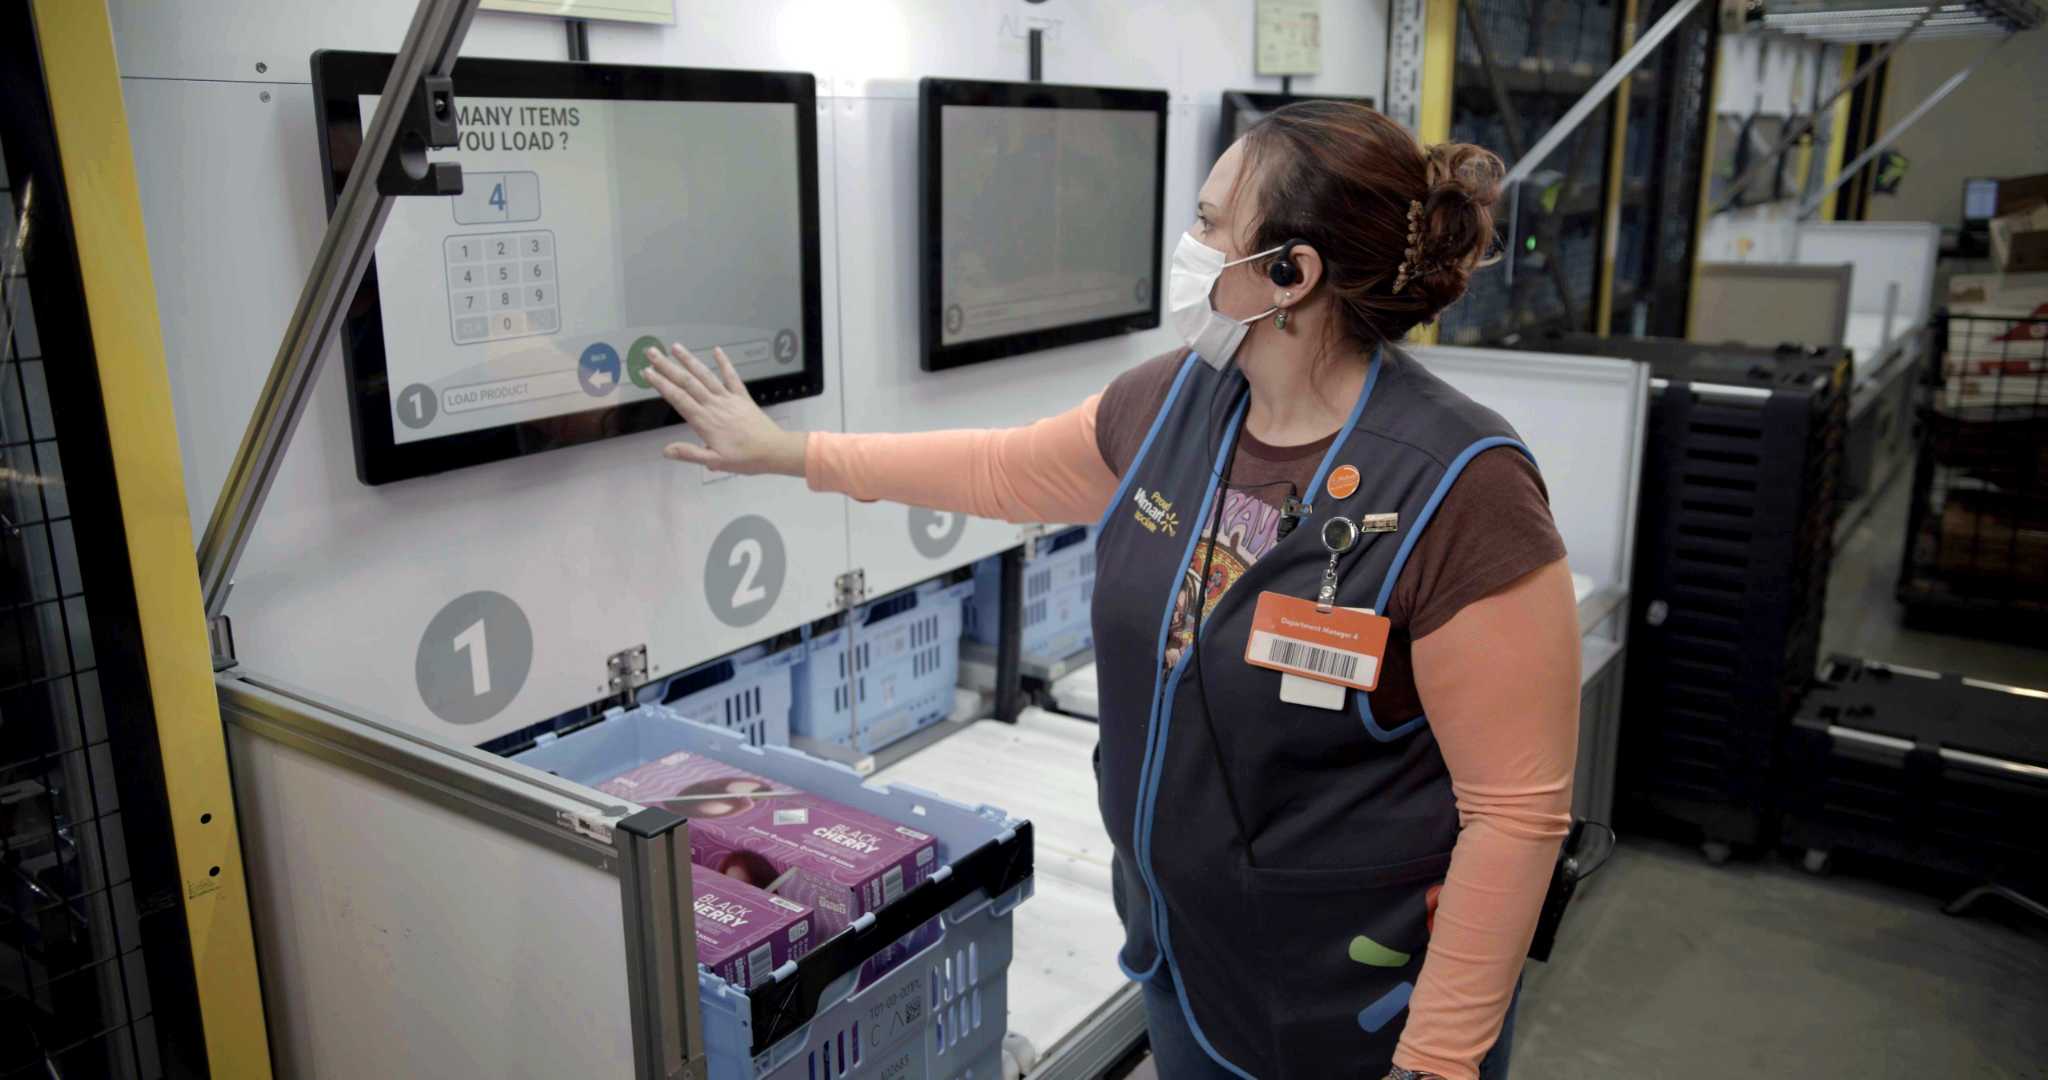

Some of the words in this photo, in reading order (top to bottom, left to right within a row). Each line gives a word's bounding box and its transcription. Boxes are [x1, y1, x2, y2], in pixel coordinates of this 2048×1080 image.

[457, 105, 513, 126] MANY
[520, 106, 581, 127] ITEMS
[457, 131, 495, 151] YOU
[502, 131, 555, 151] LOAD
[488, 182, 507, 211] 4
[461, 244, 469, 258] 1
[496, 241, 505, 256] 2
[531, 239, 540, 253] 3
[463, 269, 472, 284] 4
[499, 266, 508, 281] 5
[533, 264, 542, 278] 6
[464, 295, 475, 310] 7
[501, 292, 510, 306] 8
[535, 288, 544, 302] 9
[503, 317, 512, 331] 0
[779, 333, 792, 359] 2
[409, 391, 423, 420] 1
[447, 392, 478, 406] LOAD
[480, 384, 529, 401] PRODUCT
[728, 538, 766, 608] 2
[1280, 616, 1321, 632] Department
[1322, 626, 1352, 640] Manager
[453, 617, 491, 697] 1
[812, 827, 880, 854] CHERRY
[830, 823, 883, 846] BLACK
[693, 900, 750, 928] HERRY
[698, 893, 753, 917] BLACK
